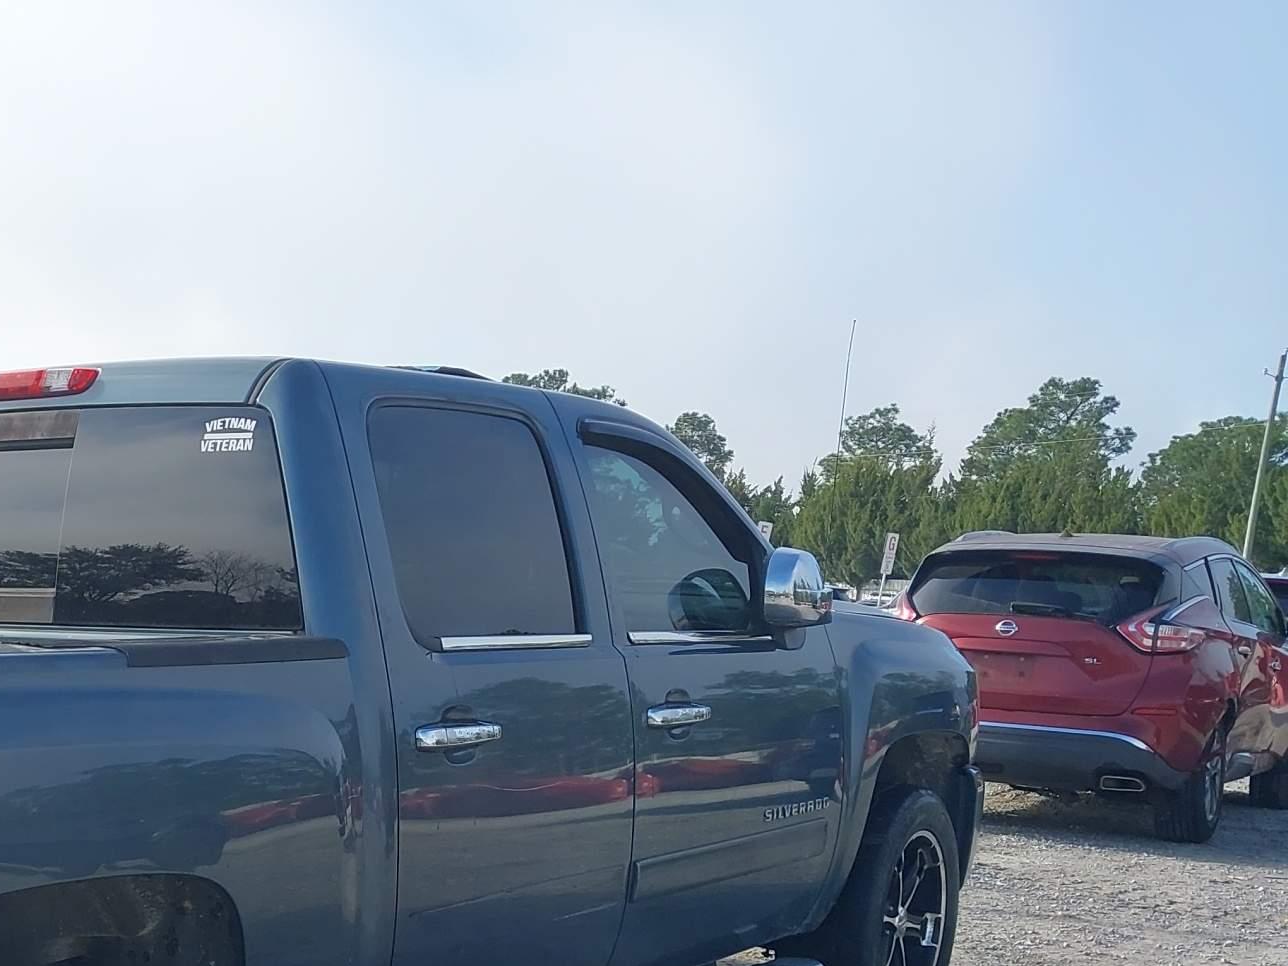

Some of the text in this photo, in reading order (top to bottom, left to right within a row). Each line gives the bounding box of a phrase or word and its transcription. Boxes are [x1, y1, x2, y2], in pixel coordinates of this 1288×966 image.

[205, 418, 257, 432] VIETNAM
[201, 439, 253, 452] VETERAN
[888, 536, 897, 551] G
[764, 797, 830, 822] SILVERADO
